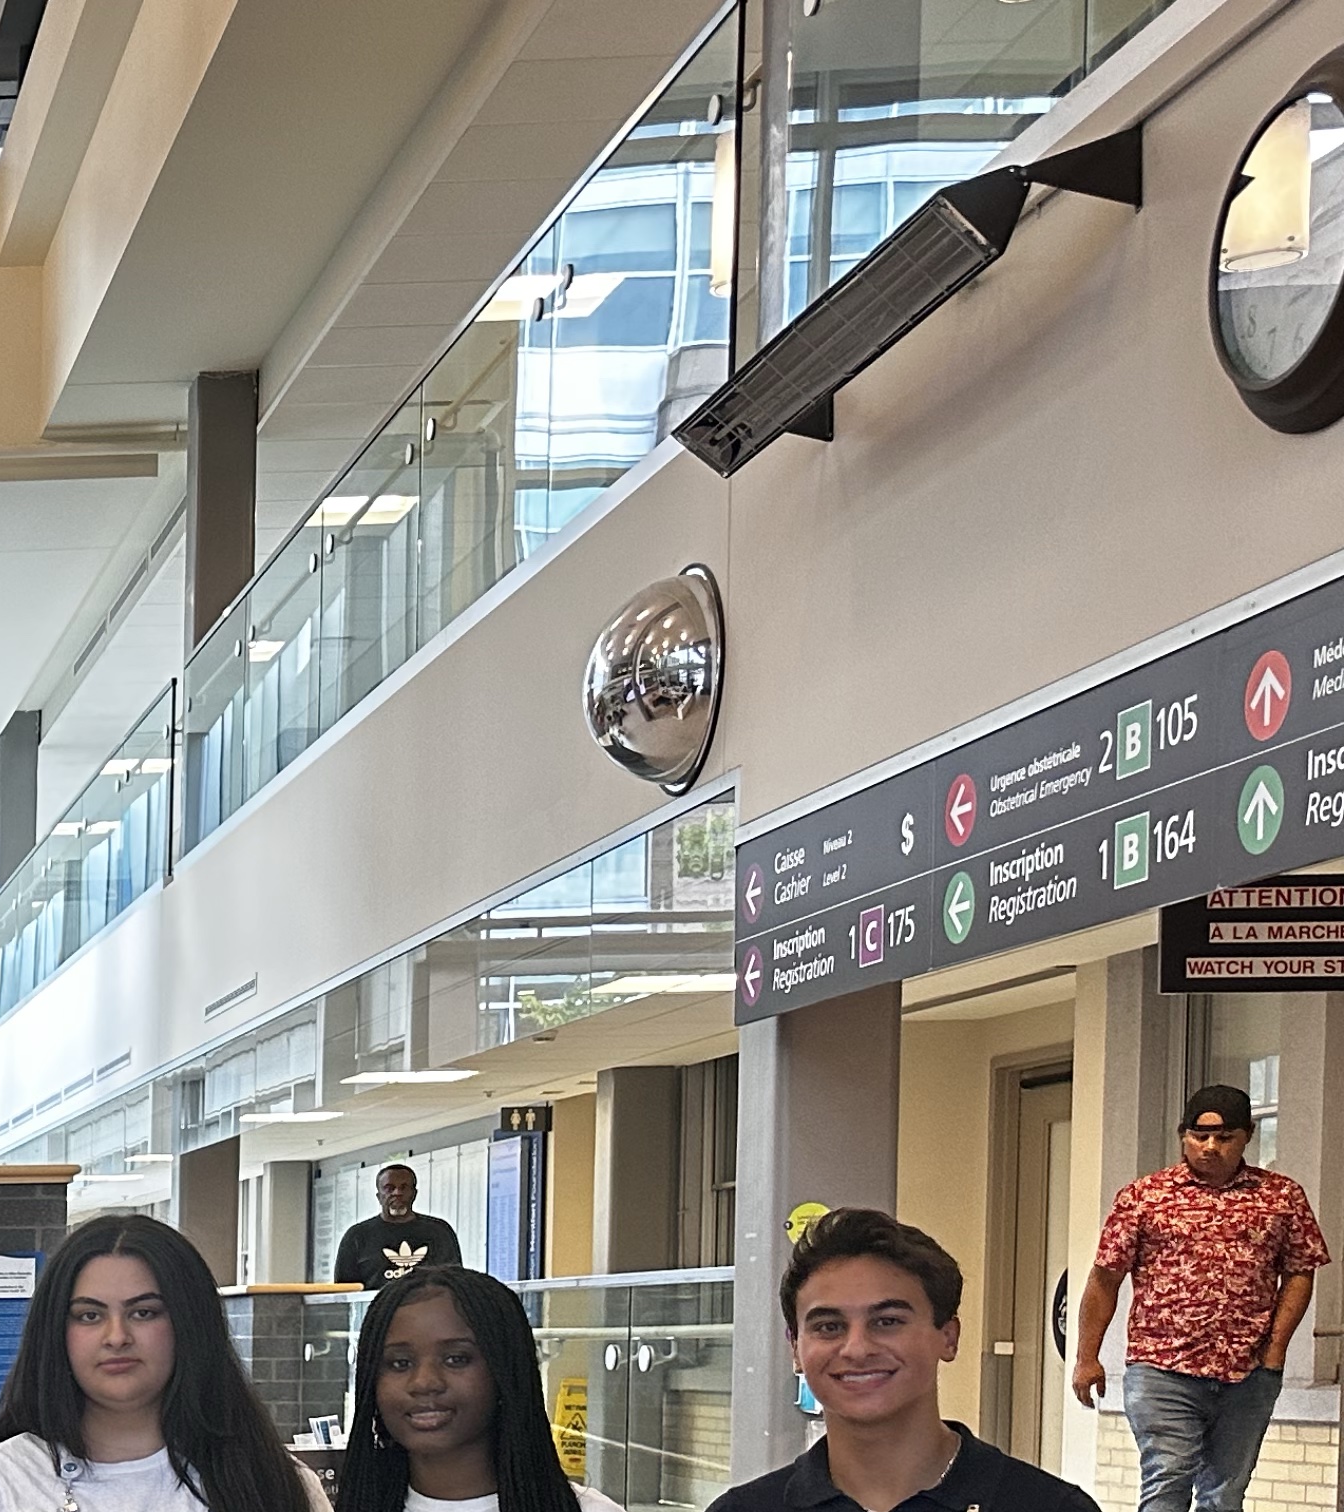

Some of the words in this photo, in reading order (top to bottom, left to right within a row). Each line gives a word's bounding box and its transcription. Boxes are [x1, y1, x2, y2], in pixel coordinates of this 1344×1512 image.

[990, 766, 1026, 792] Urgence
[1027, 741, 1081, 777] obstétricale
[1098, 730, 1113, 774] 2
[1125, 721, 1141, 761] B
[1156, 694, 1198, 750] 105
[989, 786, 1038, 818] Obstetrical
[1039, 766, 1093, 799] Emergency
[774, 847, 806, 875] Caisse
[847, 829, 853, 845] 2
[901, 812, 914, 856] $
[989, 842, 1064, 887] Inscription
[1098, 839, 1109, 881] 1
[1122, 832, 1139, 871] B
[1153, 809, 1196, 863] 164
[774, 872, 812, 905] Cashier
[822, 867, 842, 887] Level
[841, 863, 848, 880] 2
[988, 875, 1077, 926] Registration
[773, 925, 826, 961] Inscription
[848, 925, 856, 960] 1
[865, 920, 878, 952] C
[887, 904, 915, 948] 175
[1233, 926, 1258, 940] LA
[772, 952, 835, 994] Registration
[1187, 960, 1253, 975] WATCH
[1262, 960, 1315, 974] YOUR
[1323, 959, 1344, 974] ST
